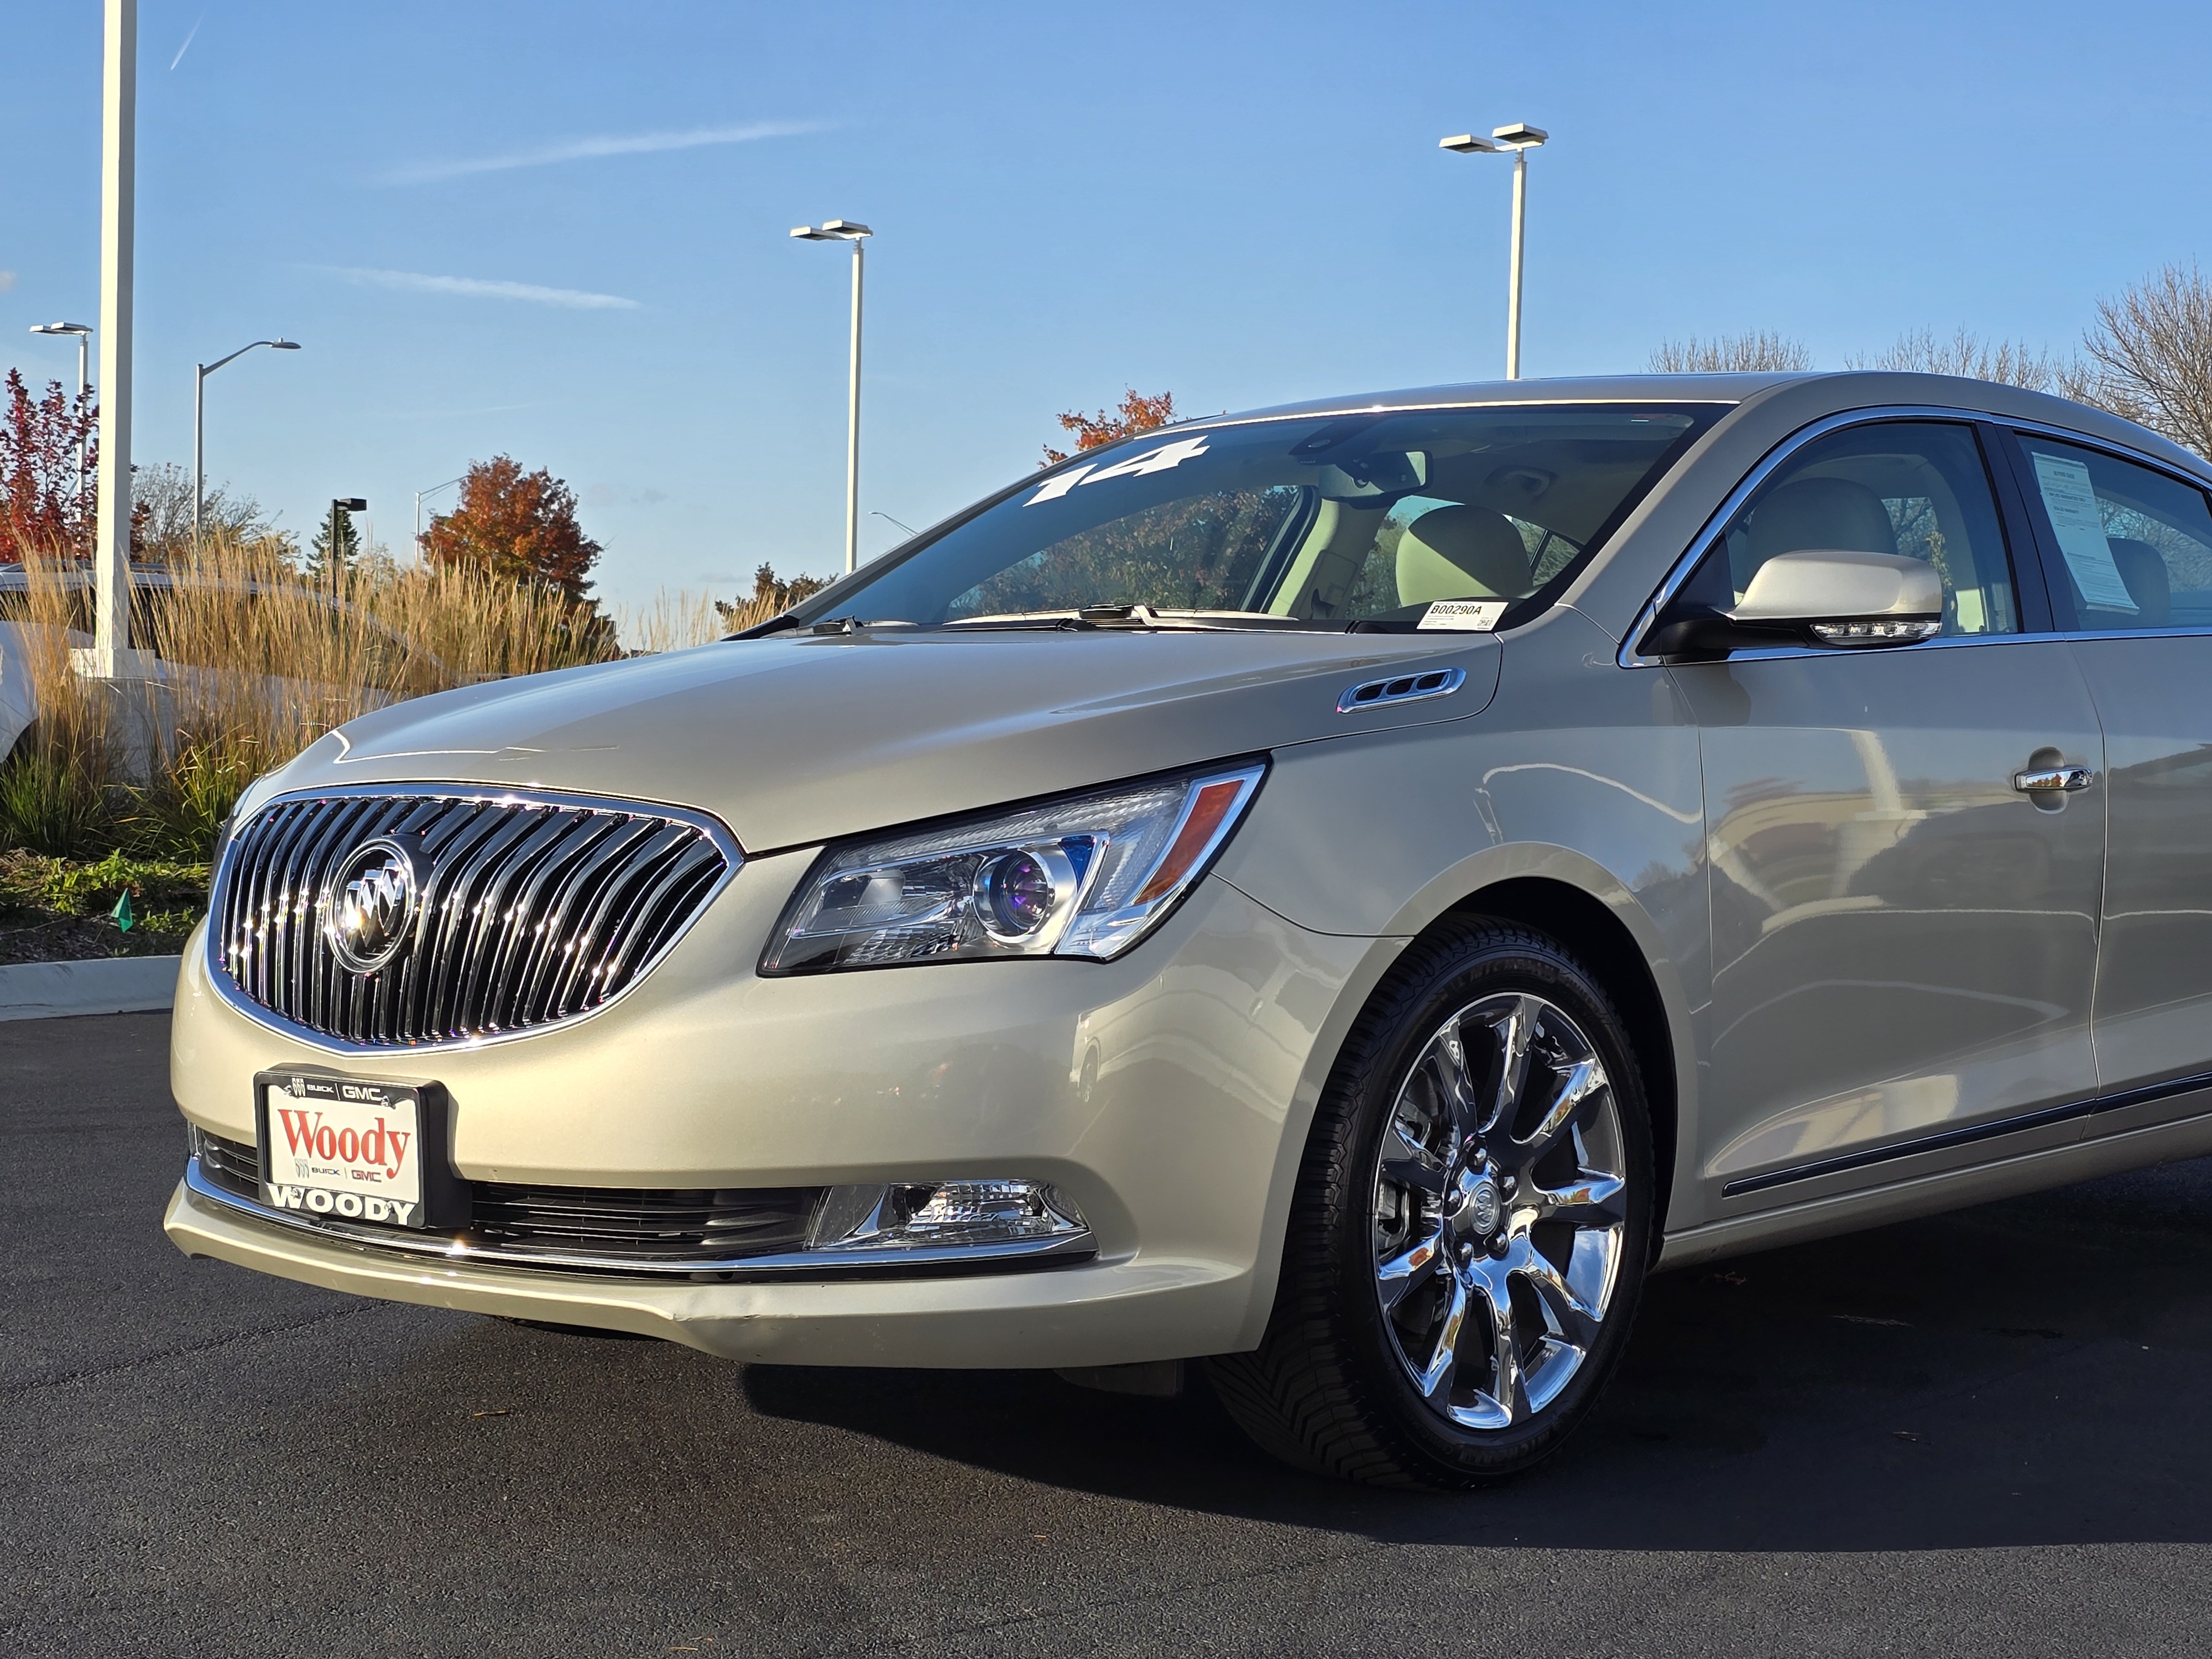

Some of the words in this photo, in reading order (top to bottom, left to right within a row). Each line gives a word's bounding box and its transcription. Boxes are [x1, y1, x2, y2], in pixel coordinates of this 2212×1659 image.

[1430, 605, 1483, 615] B00290A
[306, 1083, 335, 1093] BUICK
[342, 1086, 383, 1101] GMC
[278, 1109, 411, 1179] Woody
[311, 1167, 341, 1176] BUICK
[351, 1169, 382, 1183] GMC
[268, 1185, 415, 1225] WOODY
